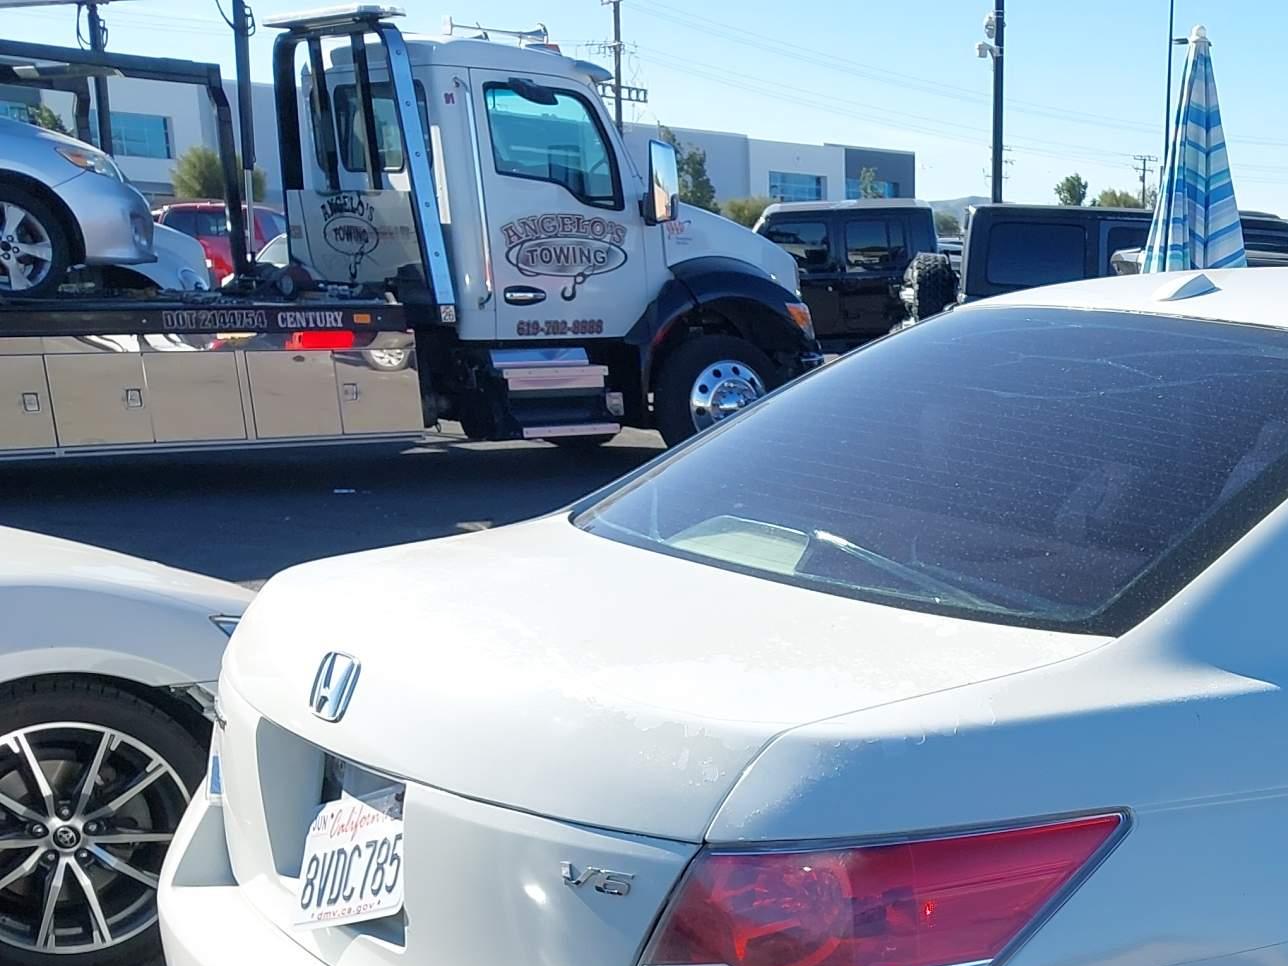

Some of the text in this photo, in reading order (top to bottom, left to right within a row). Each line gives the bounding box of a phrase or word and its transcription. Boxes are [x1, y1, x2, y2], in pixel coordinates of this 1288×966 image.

[500, 214, 627, 248] ANGELO'S
[527, 246, 608, 266] TOWING
[162, 310, 196, 329] DOT
[277, 311, 344, 328] CENTURY
[312, 815, 328, 832] JUN
[301, 832, 402, 910] 8VDC785
[560, 861, 635, 896] V6
